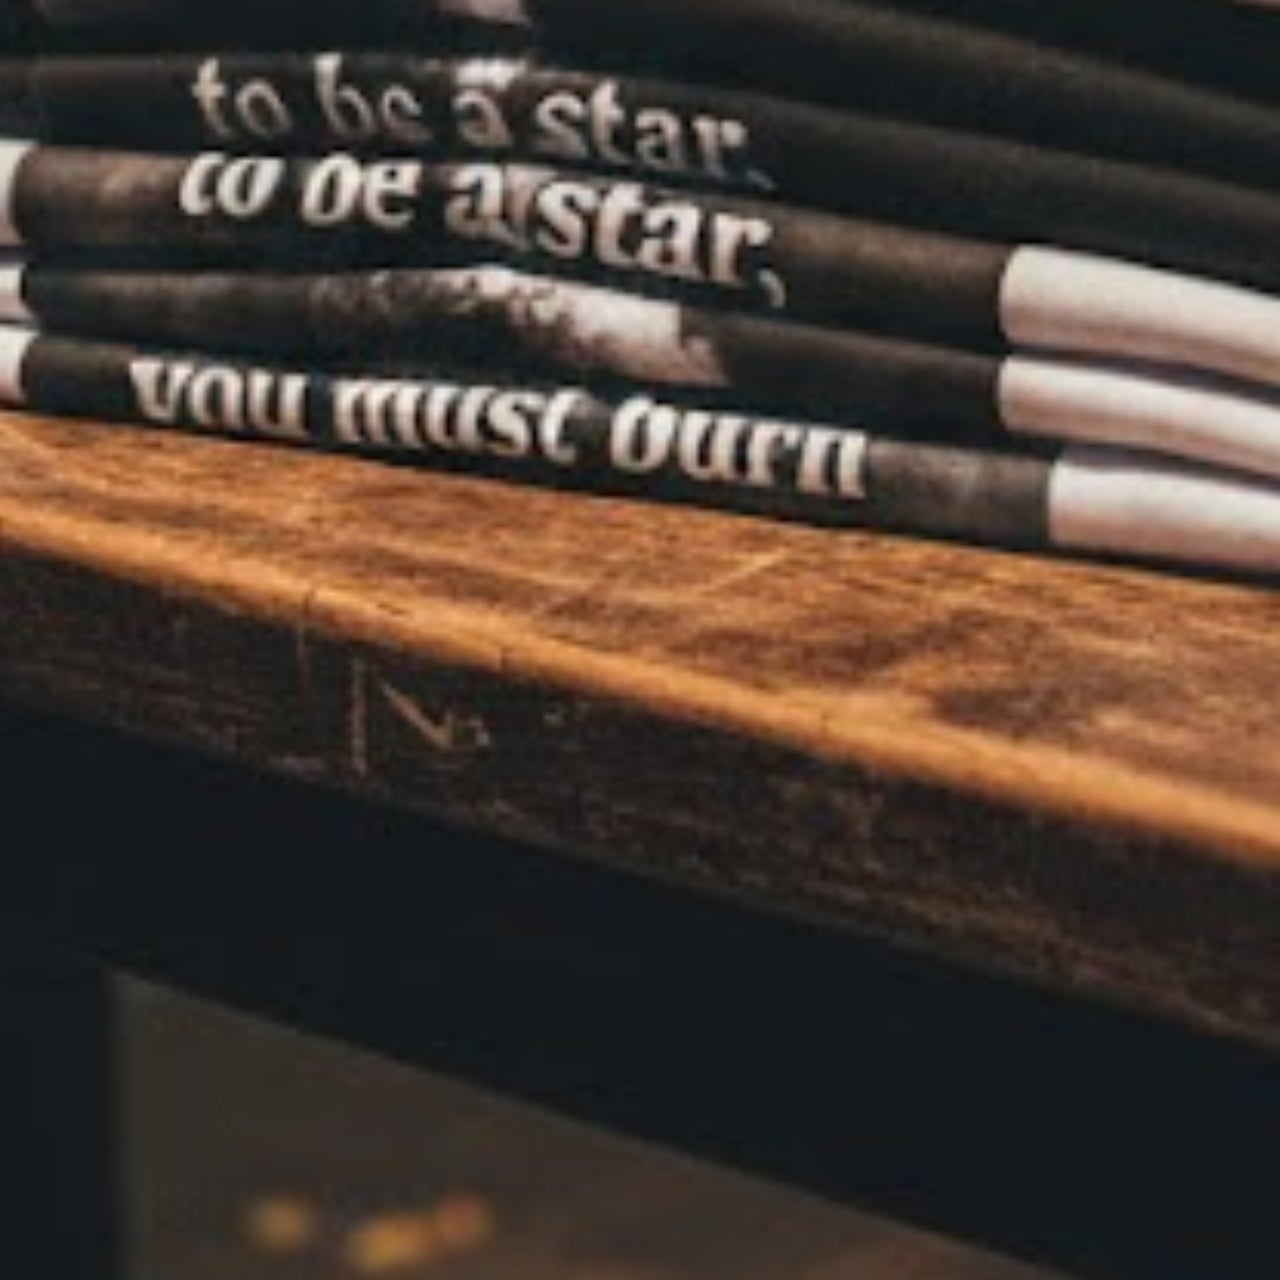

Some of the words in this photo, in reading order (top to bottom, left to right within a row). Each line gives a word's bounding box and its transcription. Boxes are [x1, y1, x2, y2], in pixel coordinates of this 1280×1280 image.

[192, 56, 293, 137] to
[314, 52, 434, 142] be
[535, 180, 787, 308] star,
[329, 376, 593, 466] must
